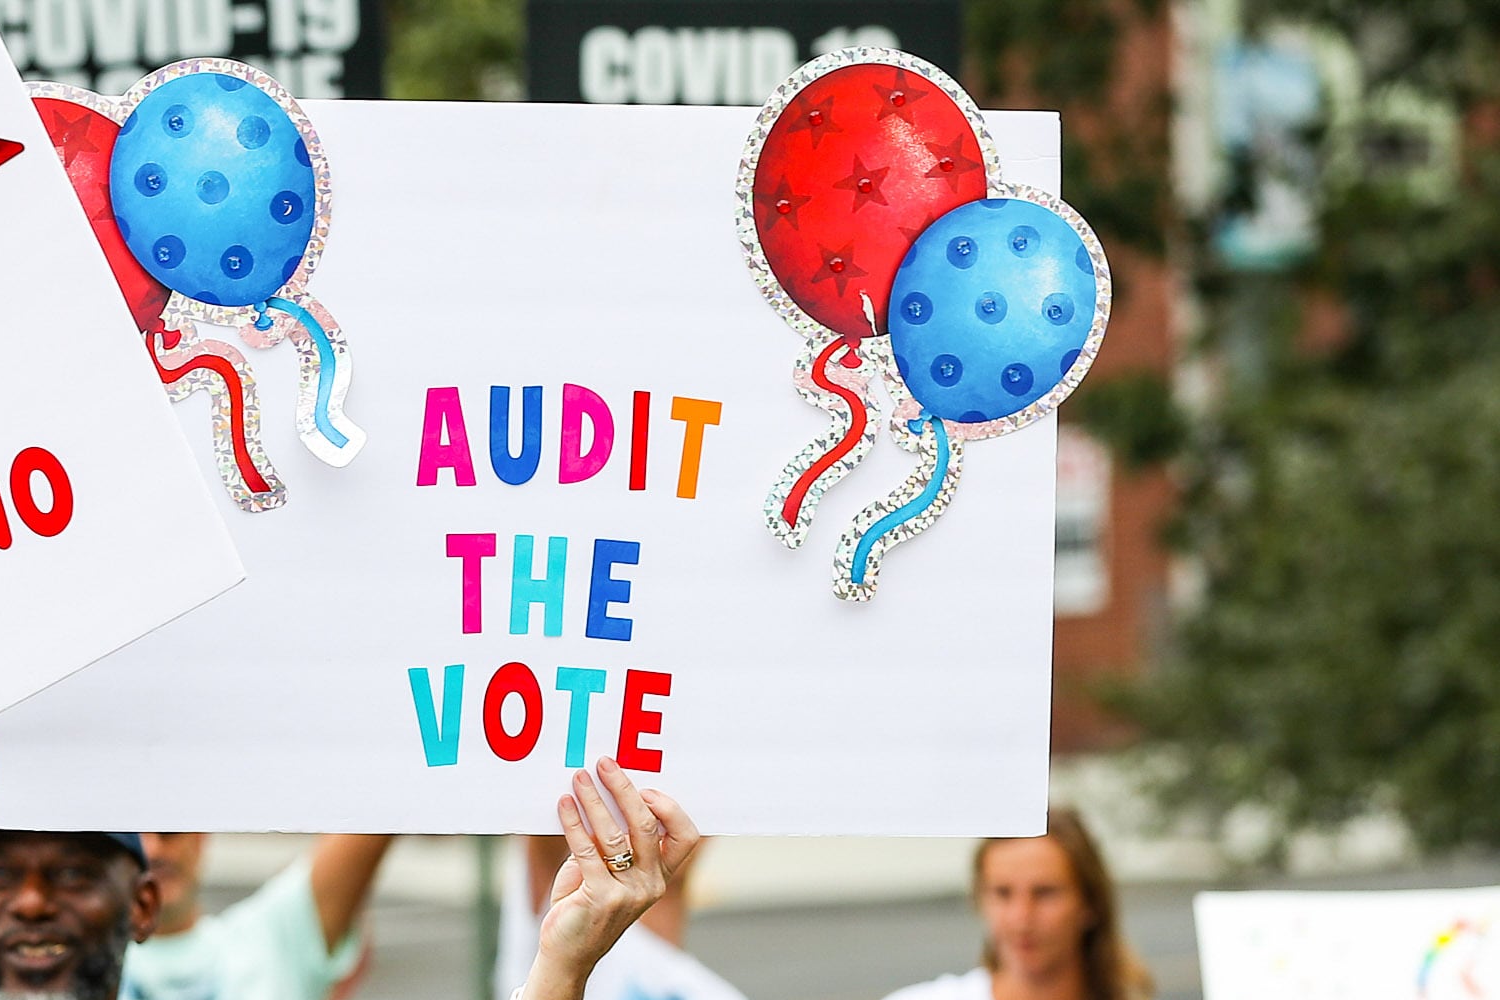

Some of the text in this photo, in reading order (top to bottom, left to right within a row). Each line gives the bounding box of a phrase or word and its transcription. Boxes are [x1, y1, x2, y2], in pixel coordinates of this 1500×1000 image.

[580, 24, 900, 103] COVID
[417, 383, 722, 499] AUDIT
[446, 533, 640, 641] THE
[408, 662, 671, 772] VOTE
